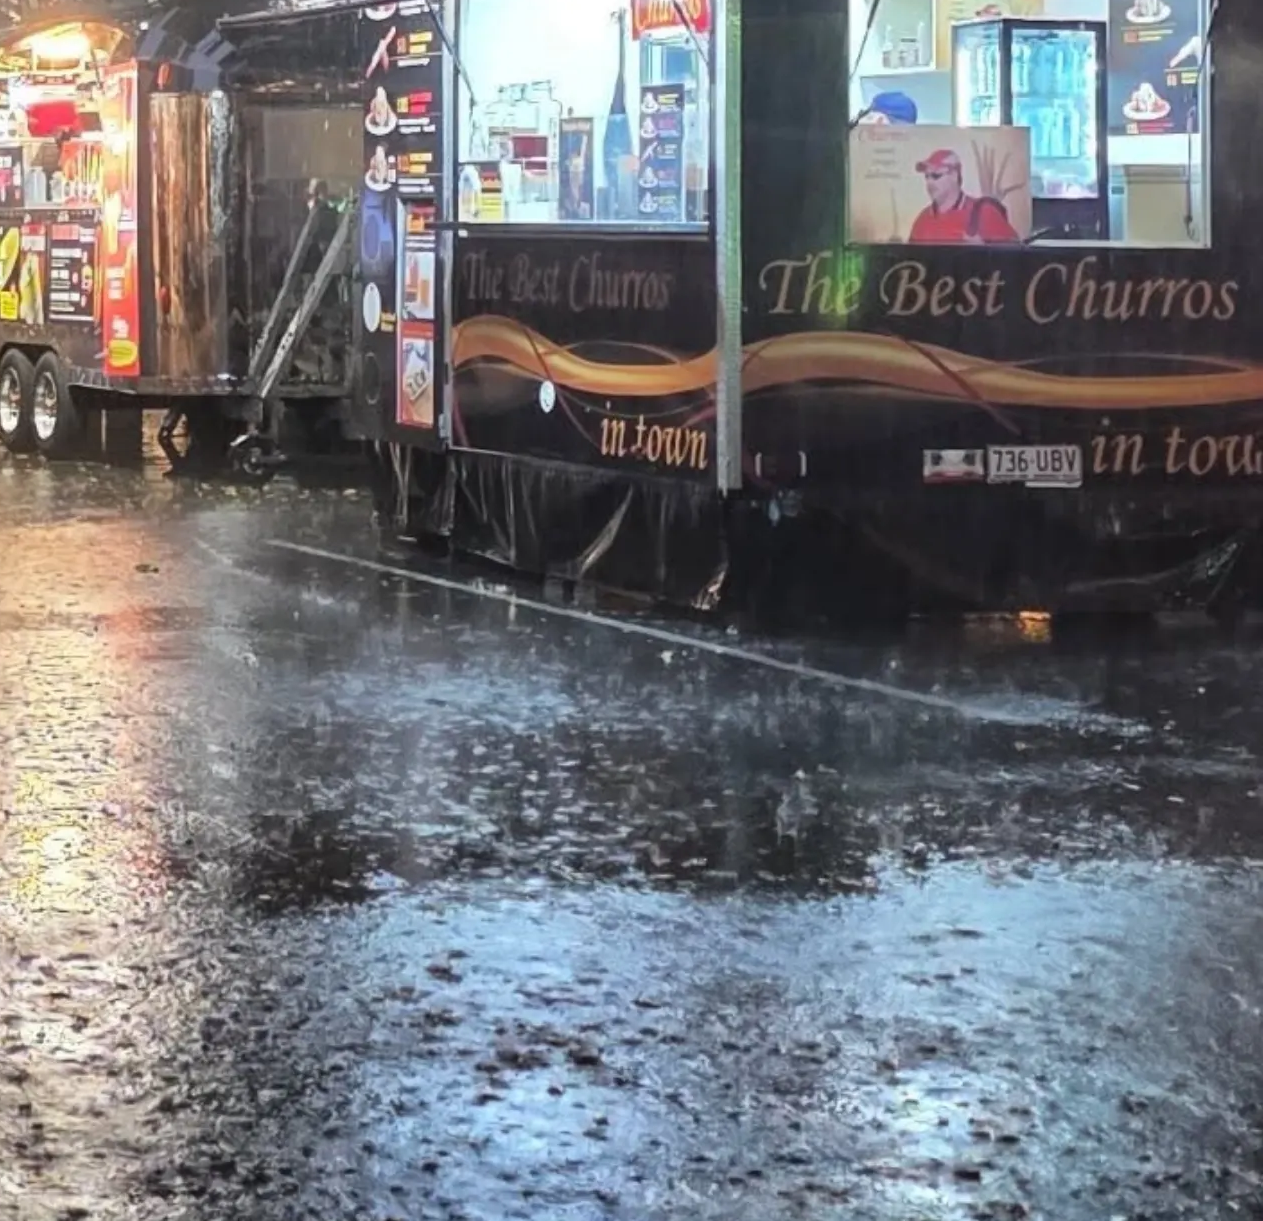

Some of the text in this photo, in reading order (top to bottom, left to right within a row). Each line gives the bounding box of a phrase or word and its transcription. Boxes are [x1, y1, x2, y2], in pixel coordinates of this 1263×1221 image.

[463, 252, 673, 313] The Best Churros
[760, 252, 1240, 324] The Best Churros
[601, 401, 709, 470] in town
[1092, 417, 1146, 475] in
